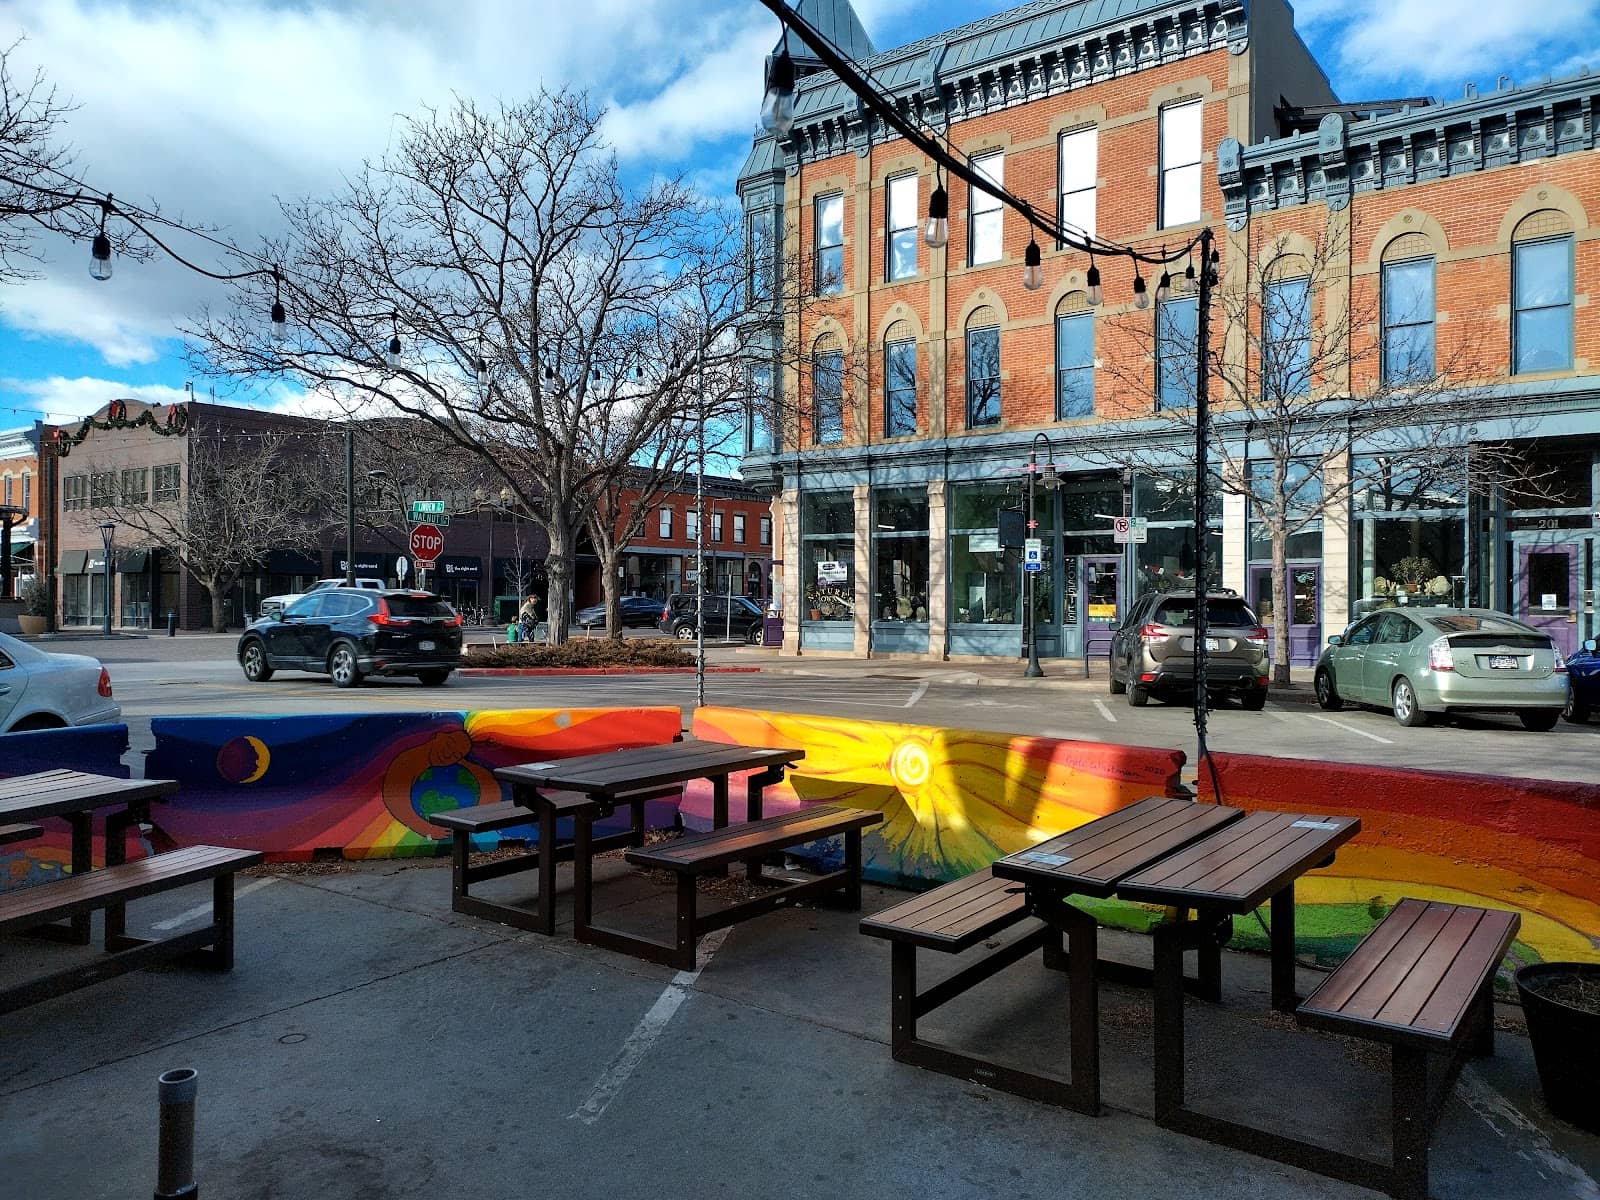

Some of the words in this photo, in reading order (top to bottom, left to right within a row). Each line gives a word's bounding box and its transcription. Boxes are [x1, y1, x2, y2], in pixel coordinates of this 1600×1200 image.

[413, 512, 439, 524] WALNUT
[1538, 519, 1560, 529] 201
[412, 534, 442, 551] STOP
